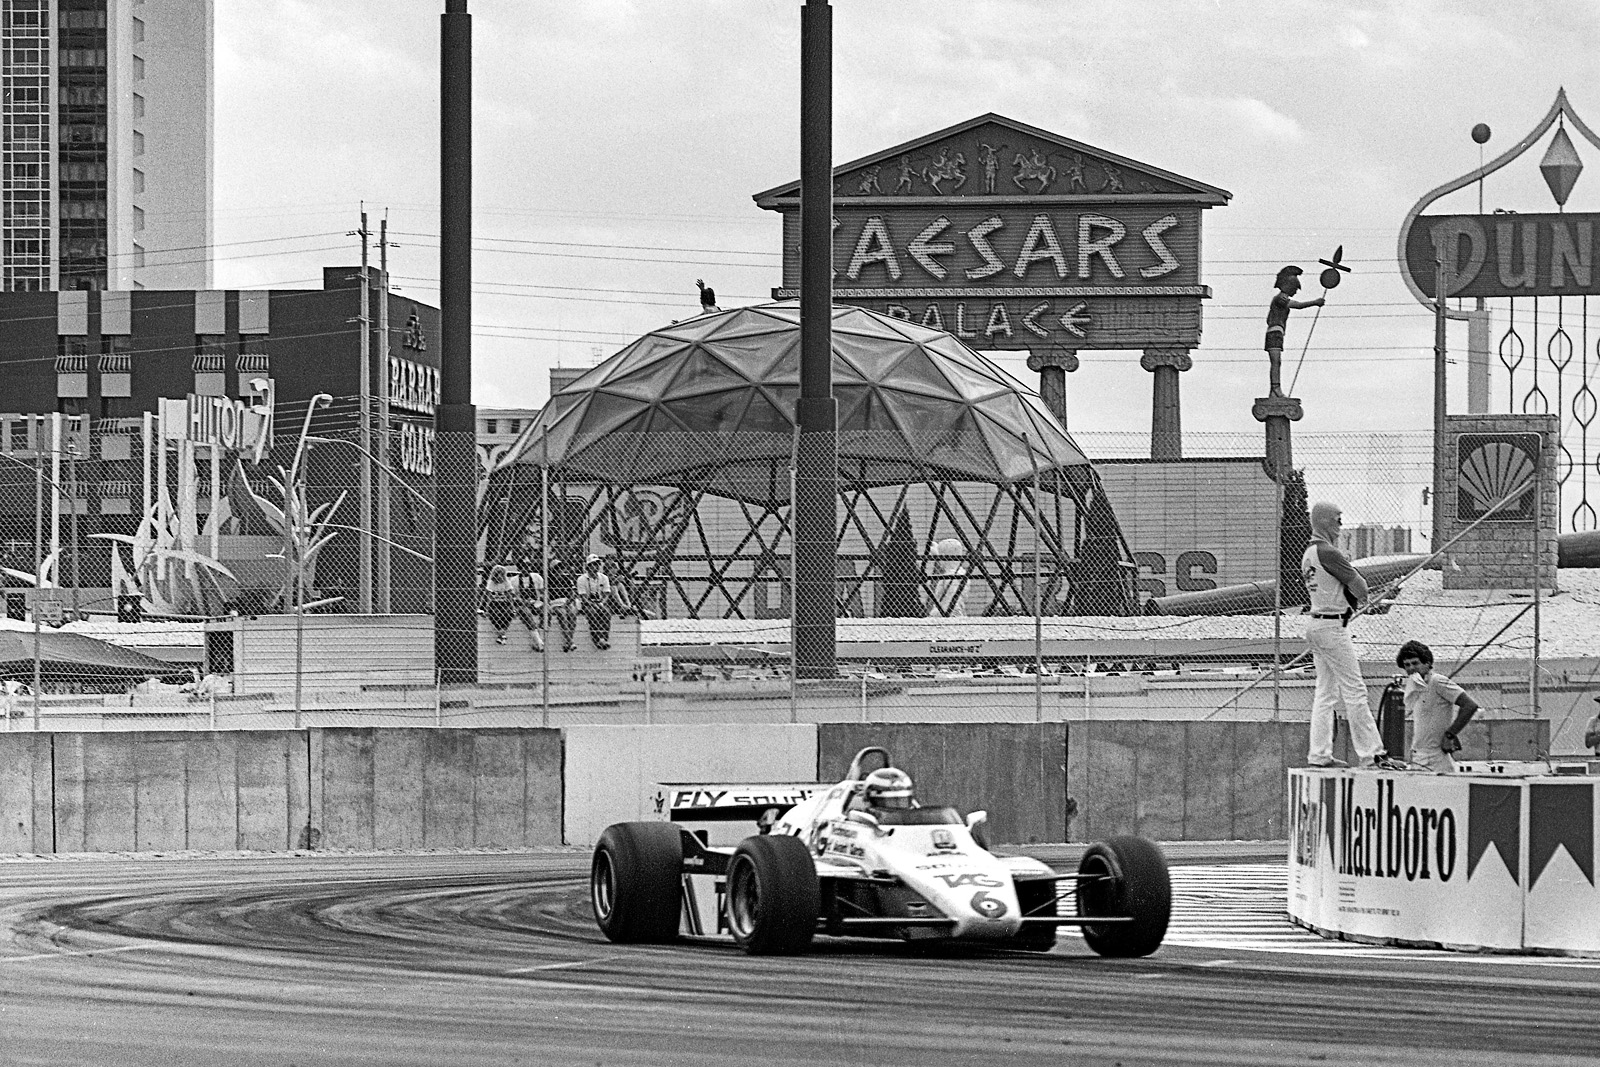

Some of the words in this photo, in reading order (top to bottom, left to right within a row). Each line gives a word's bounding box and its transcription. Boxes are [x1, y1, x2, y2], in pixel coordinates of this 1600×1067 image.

[831, 213, 1182, 280] AESARS
[673, 791, 728, 808] FLY
[1339, 777, 1456, 882] Marlboro
[970, 890, 1008, 919] 6
